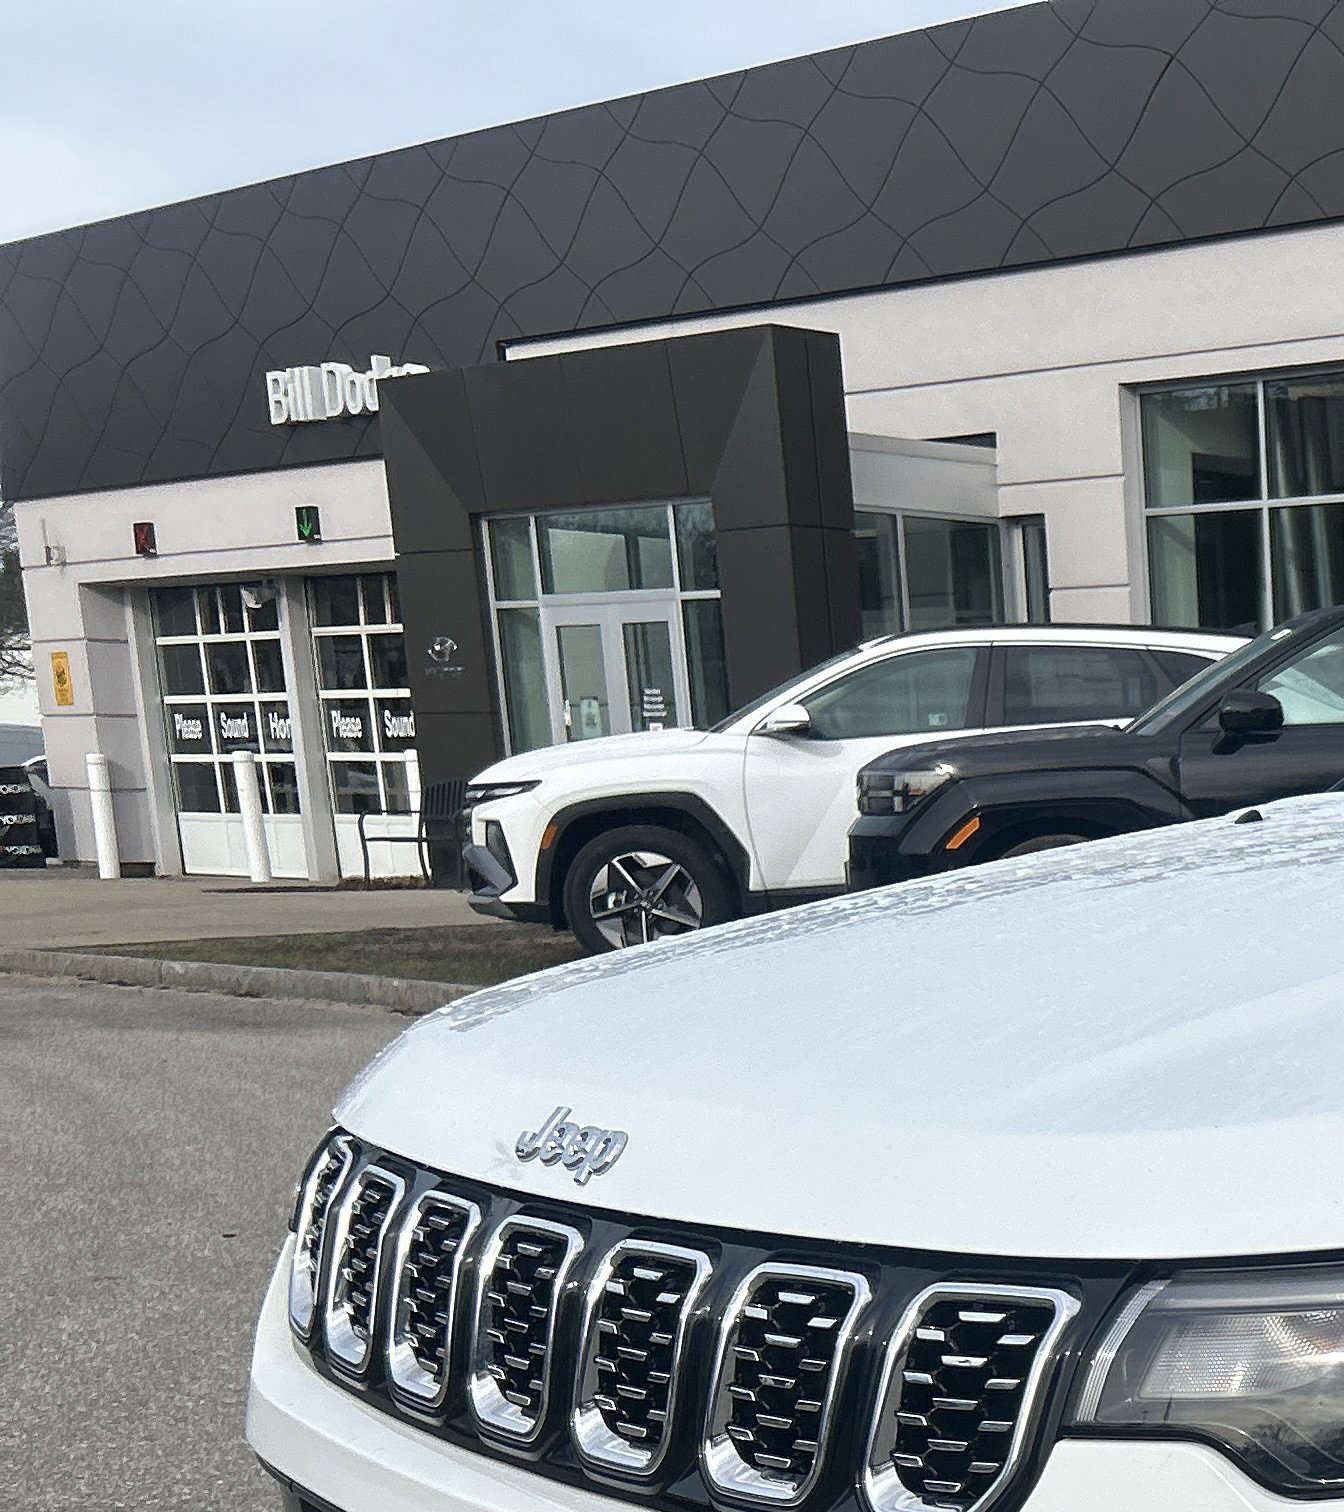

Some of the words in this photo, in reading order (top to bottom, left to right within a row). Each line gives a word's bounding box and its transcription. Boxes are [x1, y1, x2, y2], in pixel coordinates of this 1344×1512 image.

[265, 366, 326, 426] Bill
[320, 354, 432, 418] Dod
[220, 712, 249, 739] Sound
[331, 709, 363, 738] Please
[384, 709, 415, 738] Sound
[515, 1105, 629, 1186] Jeep
